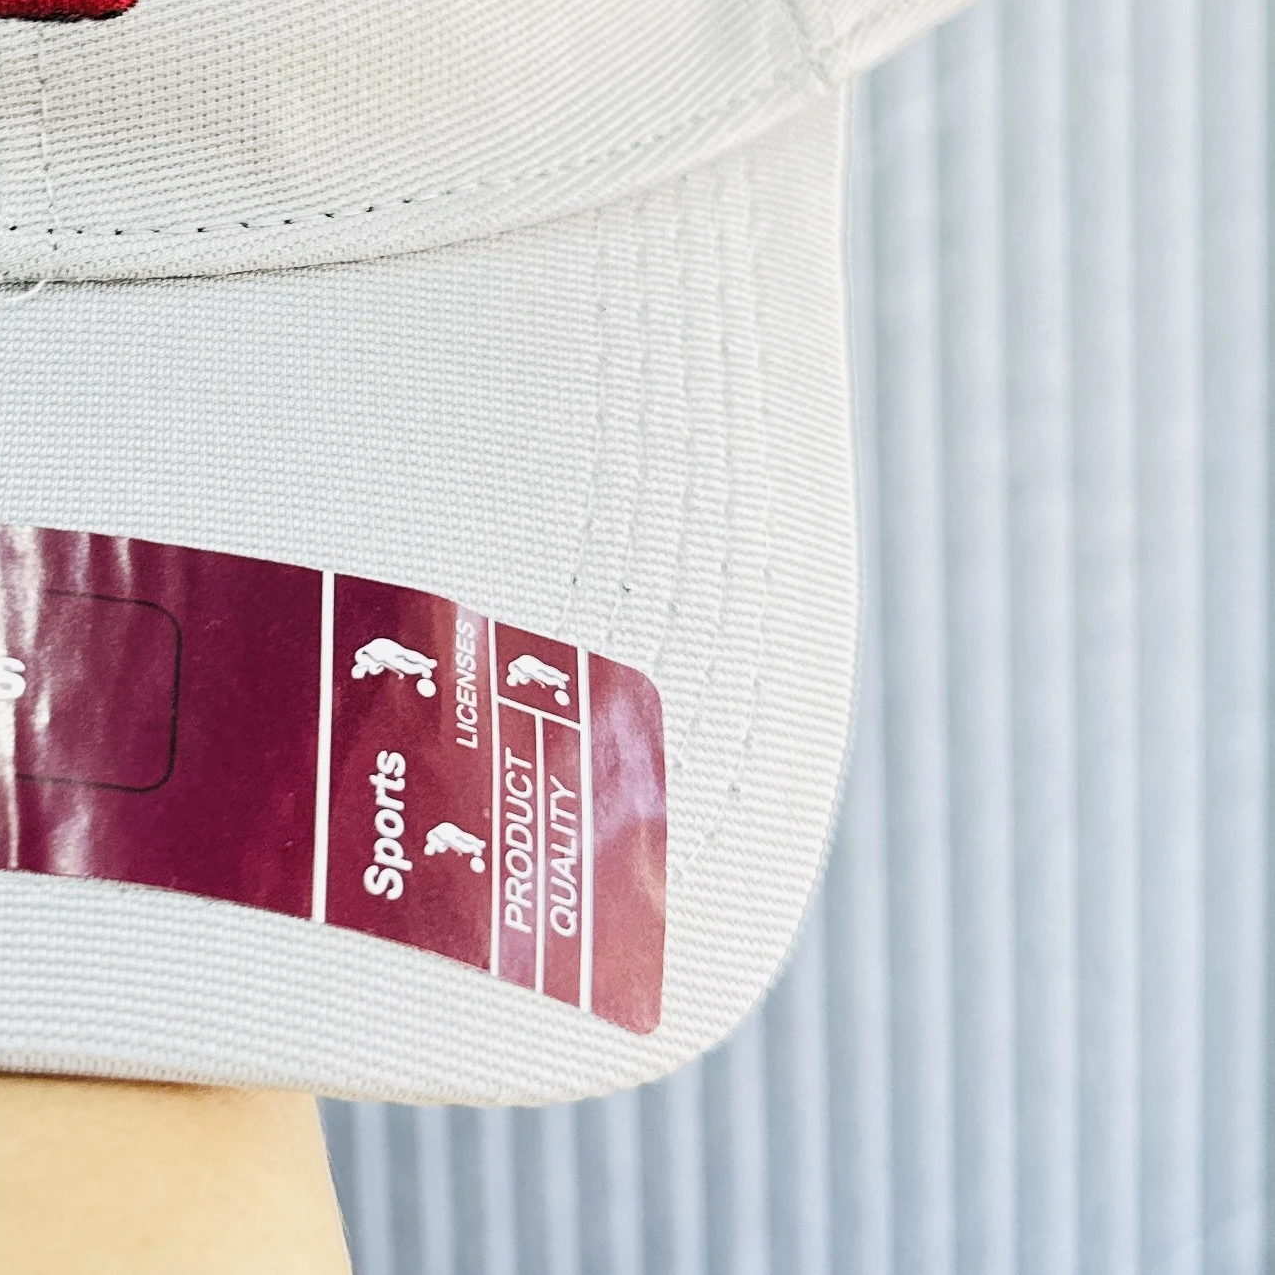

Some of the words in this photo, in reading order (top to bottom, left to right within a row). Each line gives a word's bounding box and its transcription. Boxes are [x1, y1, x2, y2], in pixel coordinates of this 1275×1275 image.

[455, 619, 478, 748] LICENSES
[364, 750, 413, 900] Sports
[505, 747, 533, 933] PRODUCT
[550, 776, 578, 937] QUALITY
